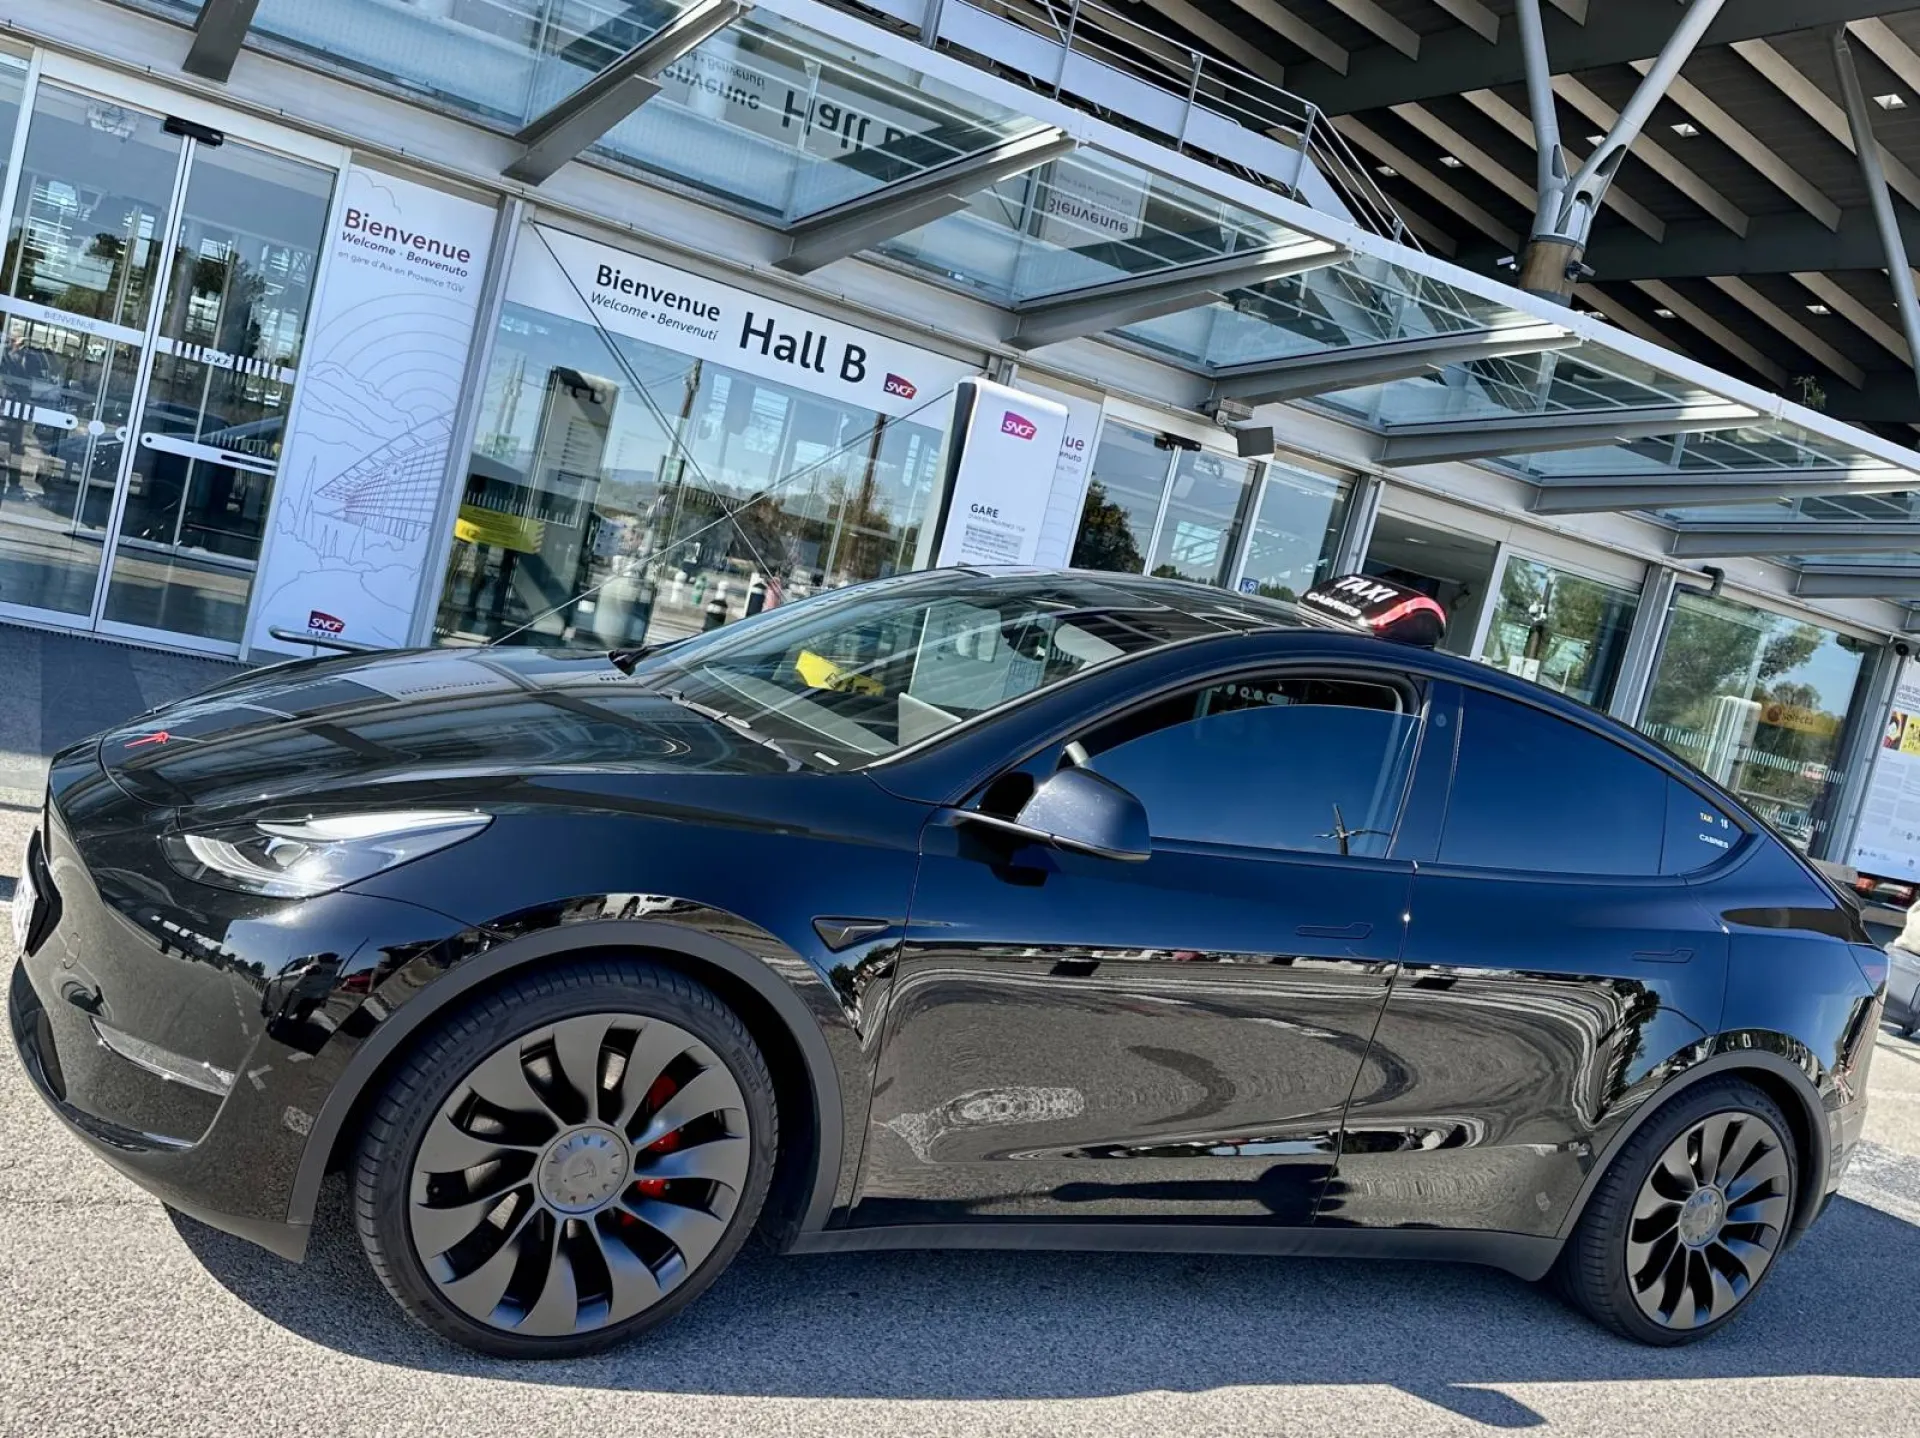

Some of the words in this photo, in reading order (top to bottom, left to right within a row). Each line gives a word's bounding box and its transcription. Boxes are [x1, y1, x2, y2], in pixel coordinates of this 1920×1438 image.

[344, 208, 471, 264] Bienvenue
[341, 231, 396, 256] Welcome
[406, 251, 468, 278] Benvenuto
[351, 255, 370, 266] gare
[407, 270, 445, 288] Provence
[595, 264, 721, 322] Bienvenue
[43, 310, 97, 332] BIENVENUE
[591, 292, 649, 320] Welcome
[657, 313, 719, 342] Benvenuti
[204, 353, 231, 367] SNCF
[738, 311, 828, 374] Hall
[839, 343, 867, 383] B
[885, 379, 915, 397] SNCF
[1002, 419, 1034, 437] SNCF
[970, 503, 999, 519] GARE
[1335, 576, 1399, 603] TAXI
[310, 618, 343, 631] SNCF
